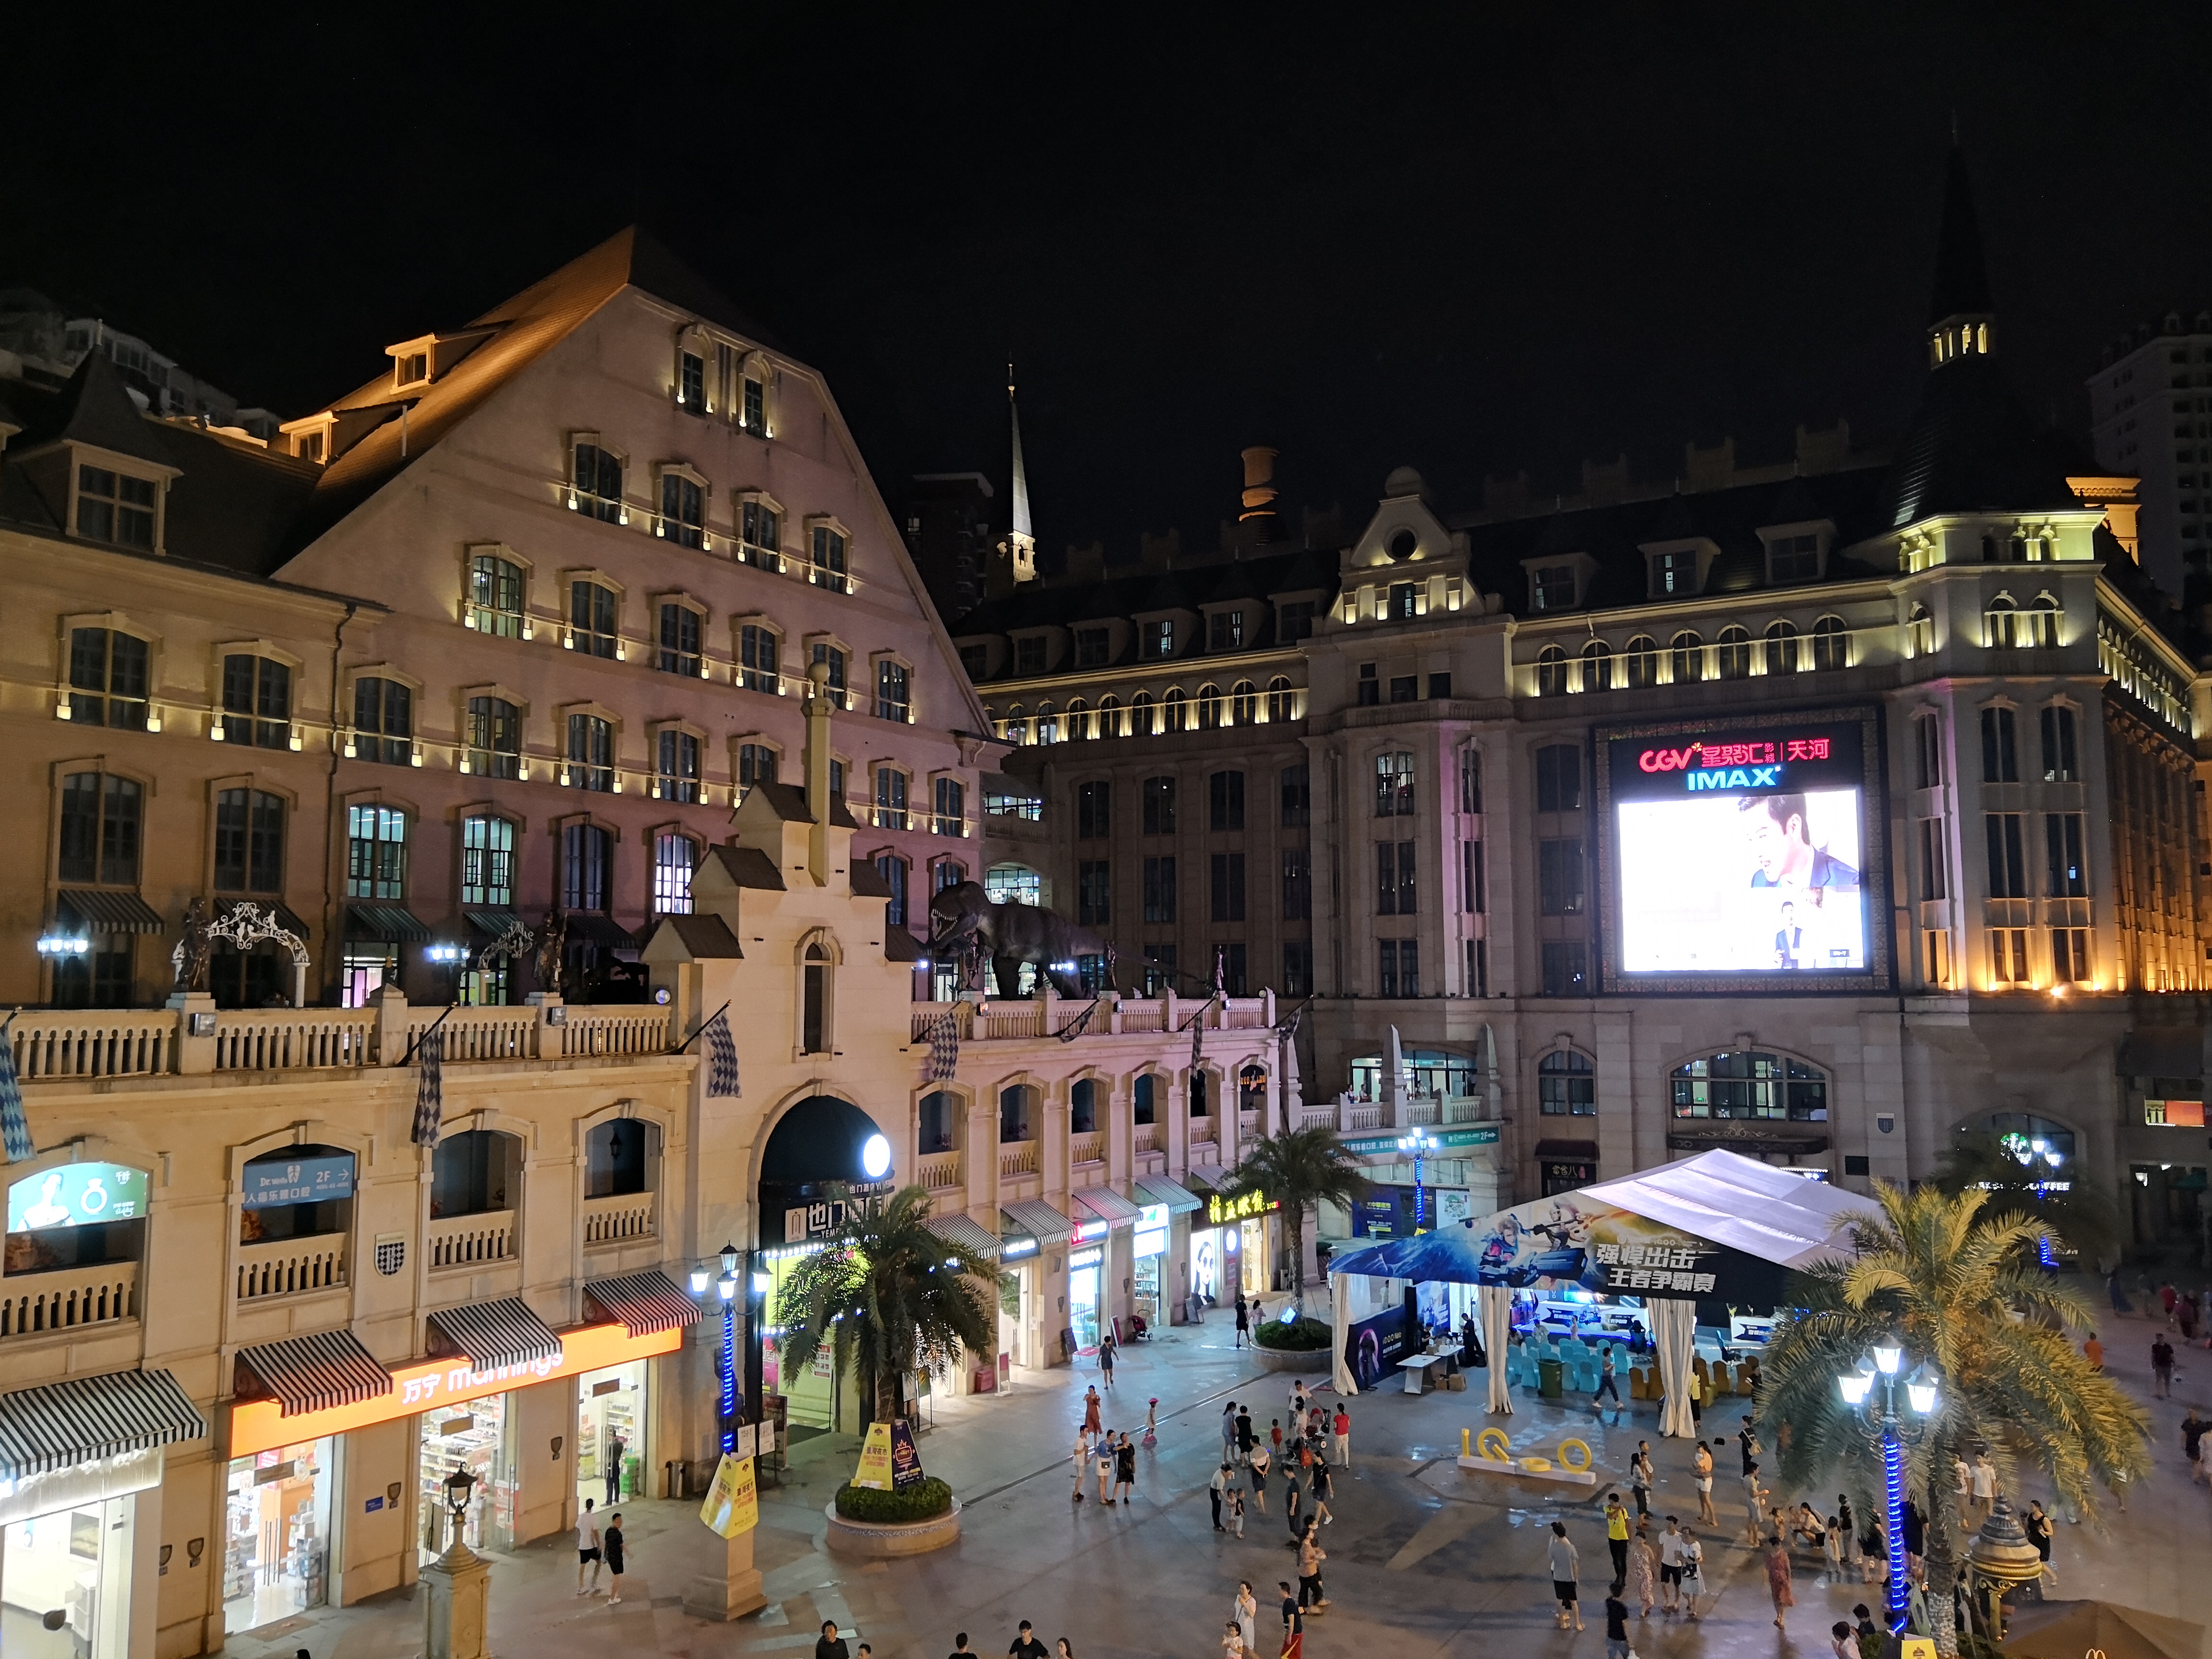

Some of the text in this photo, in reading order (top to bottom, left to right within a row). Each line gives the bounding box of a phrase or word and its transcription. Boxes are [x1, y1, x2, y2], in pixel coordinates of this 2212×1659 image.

[1639, 747, 1692, 772] CGV
[1702, 743, 1764, 767] 星聚汇
[1788, 738, 1829, 761] 天河
[1687, 768, 1776, 791] IMAX
[316, 1170, 331, 1183] 2F
[1596, 1244, 1696, 1269] 强悍出击
[1608, 1267, 1716, 1293] 王者争霸赛
[402, 1372, 441, 1400] 万宁
